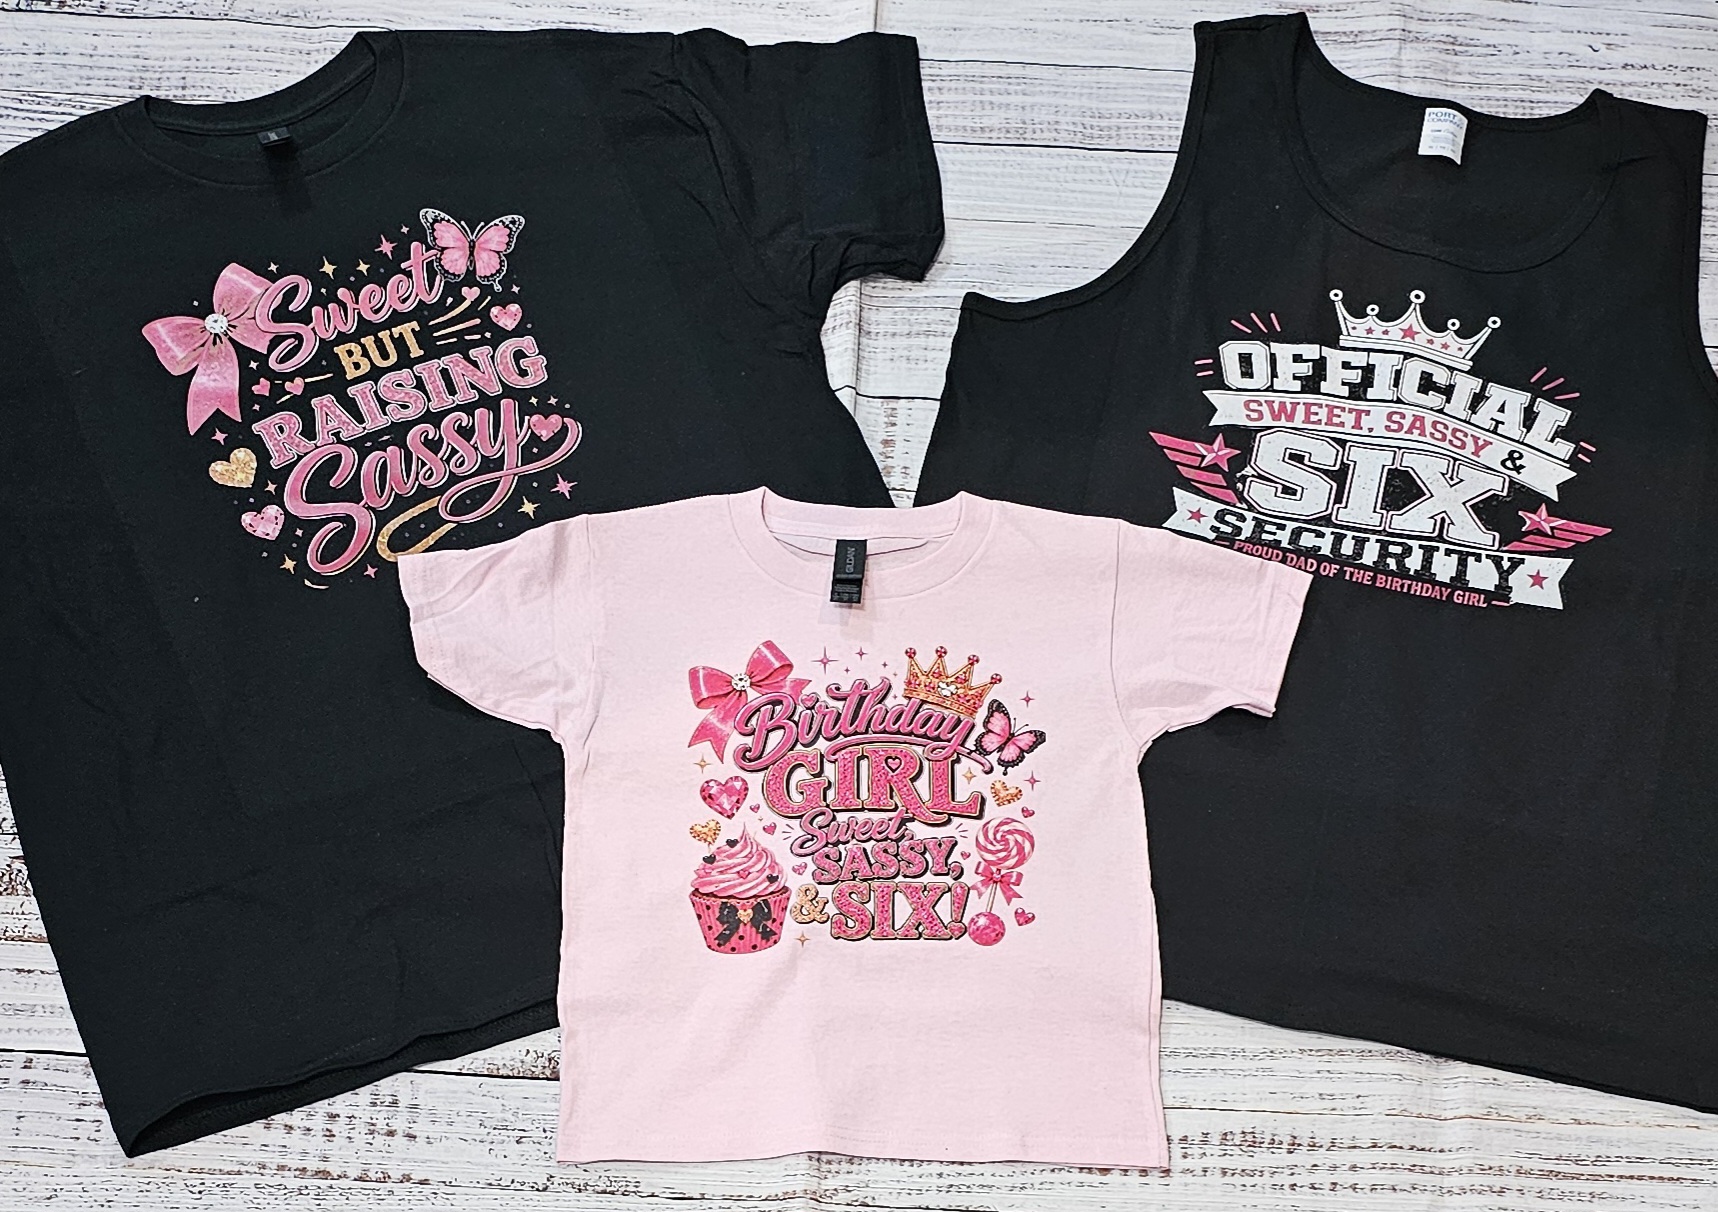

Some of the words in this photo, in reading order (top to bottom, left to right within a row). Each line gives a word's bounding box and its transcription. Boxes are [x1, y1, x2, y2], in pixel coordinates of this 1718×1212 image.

[1428, 111, 1457, 120] PORT
[255, 241, 443, 372] Sweet
[334, 321, 425, 380] BUT
[252, 336, 548, 469] RAISING
[1218, 340, 1577, 461] OFFICIAL
[1244, 399, 1374, 434] SWEET,
[1384, 410, 1494, 458] SASSY
[1500, 449, 1527, 475] &
[284, 399, 583, 576] Sassy
[1243, 427, 1510, 551] SIX
[1209, 507, 1526, 595] SECURITY
[1232, 540, 1283, 562] PROUD
[1285, 552, 1318, 572] DAD
[1319, 561, 1340, 578] OF
[1343, 566, 1374, 585] THE
[1375, 574, 1451, 601] BIRTHDAY
[1453, 590, 1489, 608] GIRL
[733, 677, 995, 774] Birthday
[763, 744, 985, 825] GIRL
[812, 836, 965, 884] SASSY,
[790, 884, 830, 924] &
[831, 881, 970, 941] SIX!
